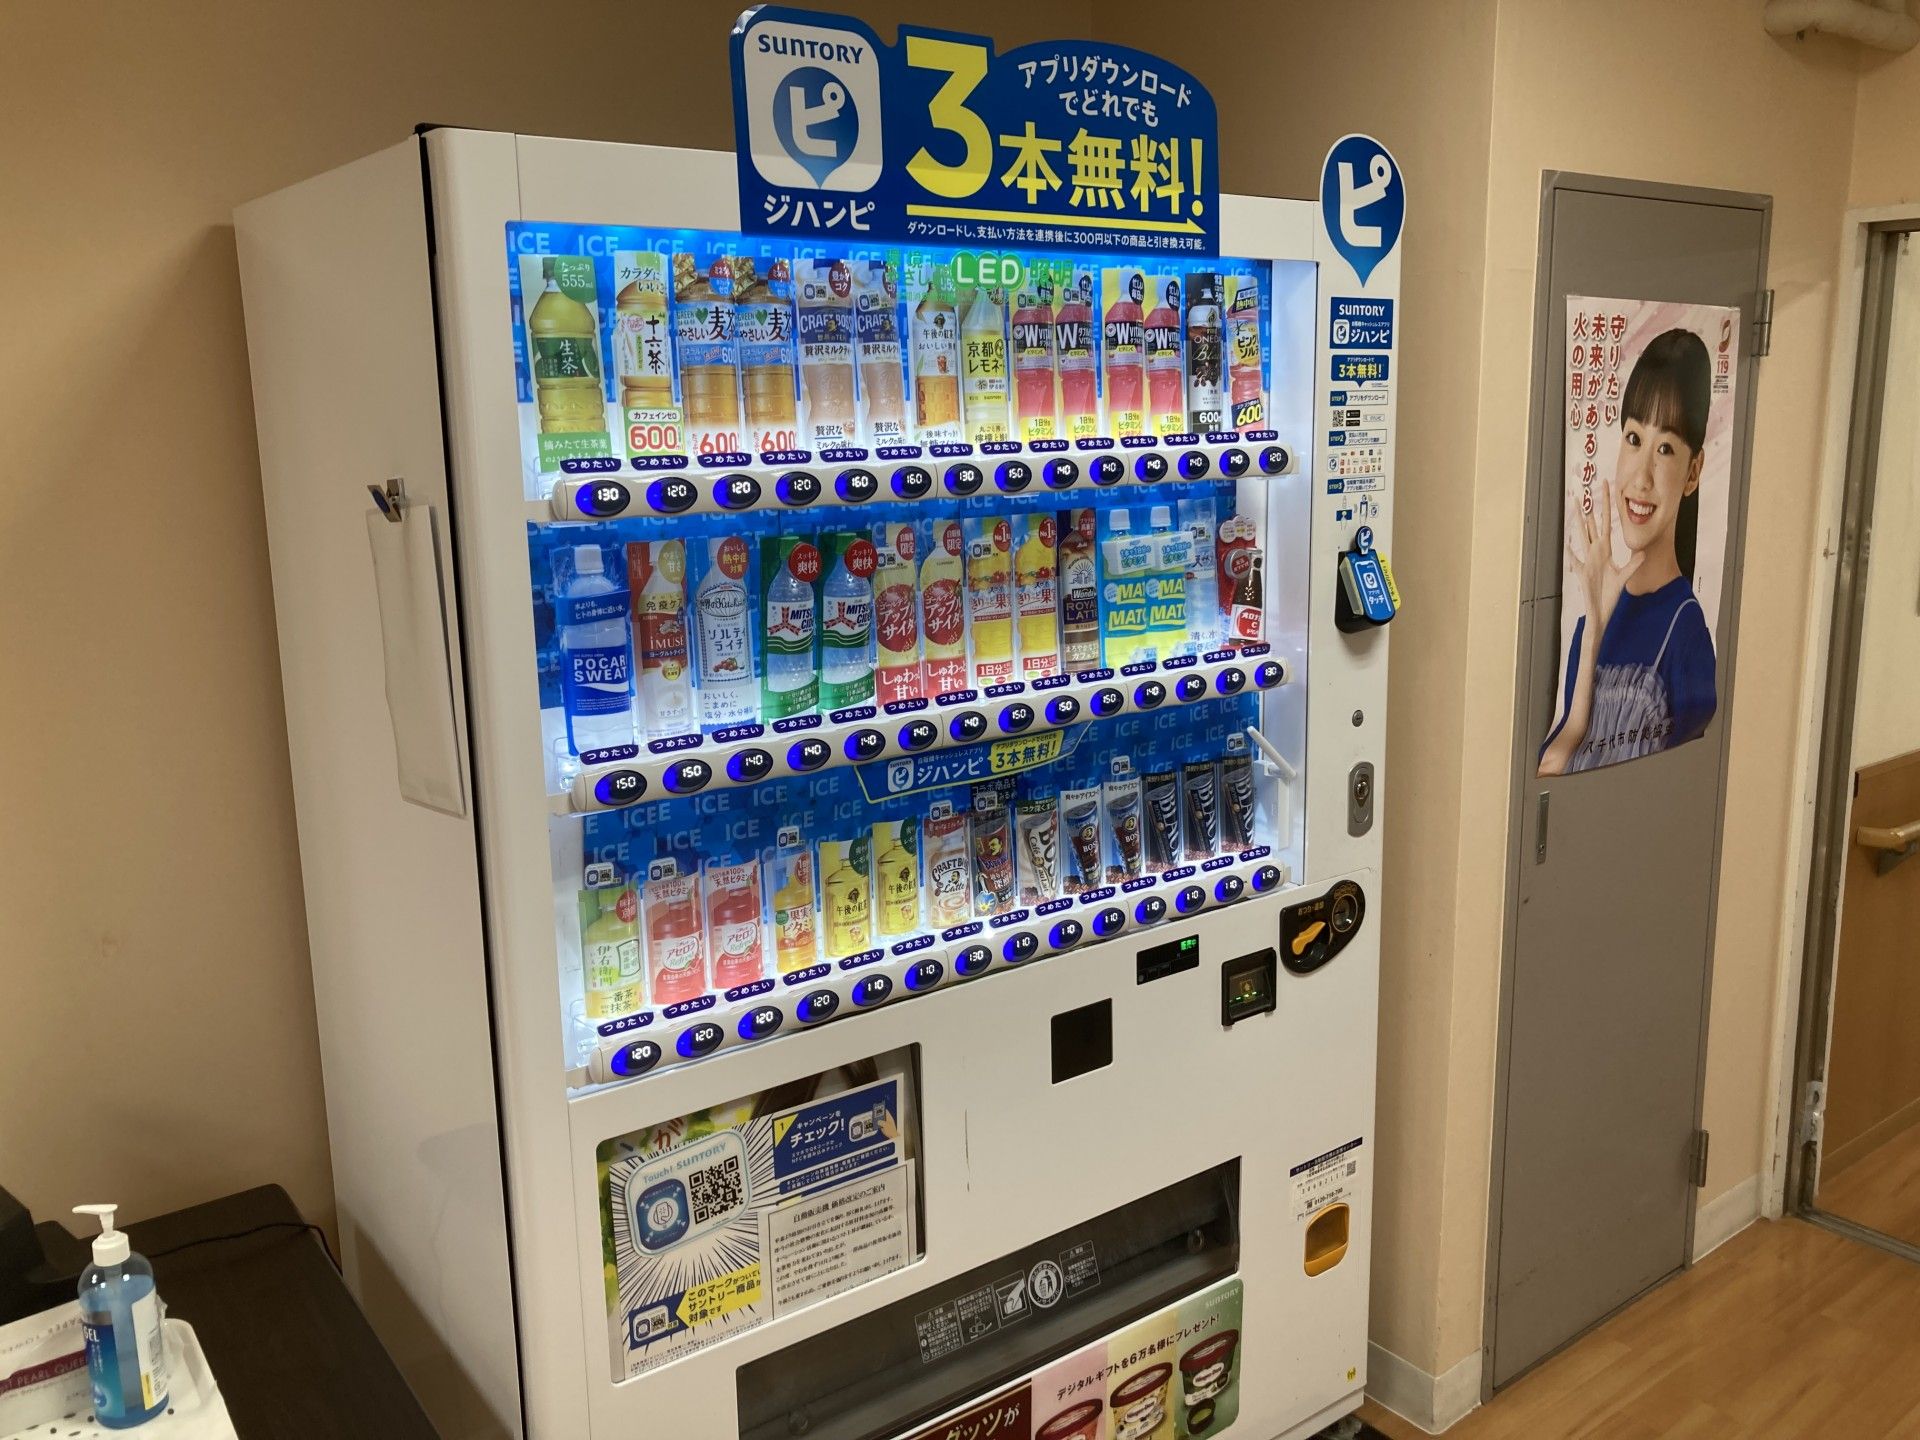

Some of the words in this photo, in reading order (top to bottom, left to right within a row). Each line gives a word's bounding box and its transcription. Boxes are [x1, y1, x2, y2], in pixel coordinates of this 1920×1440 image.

[758, 34, 865, 65] SUNTORY
[1017, 54, 1192, 108] アプリダウンロード
[1059, 90, 1159, 127] でどれでも
[1338, 154, 1392, 248] ピ
[762, 194, 876, 231] ジハンピ
[907, 221, 1207, 251] ダウンロードし、支払い方法を連携後に300円以下の商品と引き換え可能。
[561, 262, 591, 273] たっぷり
[620, 266, 661, 281] カラダに
[956, 257, 1020, 285] LED
[1339, 304, 1385, 316] SUNTORY
[678, 328, 709, 342] やさしい
[739, 329, 770, 342] やさしい
[1024, 324, 1039, 348] W
[1057, 323, 1079, 349] W
[1116, 323, 1130, 346] W
[1154, 328, 1168, 349] W
[1351, 329, 1390, 343] ジハンピ
[644, 314, 665, 374] 十六茶
[558, 340, 579, 375] 生茶
[1339, 363, 1382, 379] 3本無料!
[1570, 312, 1588, 429] 火の用心
[1605, 314, 1626, 424] 守りたい
[1717, 360, 1729, 374] 119
[633, 411, 678, 420] カフェインゼロ
[1236, 404, 1262, 426] 600
[1582, 313, 1607, 514] 未来があるから
[816, 424, 844, 436] 贅沢な
[1207, 432, 1238, 441] つめたい
[1033, 441, 1067, 449] つめたい
[1125, 437, 1155, 445] つめたい
[1168, 434, 1197, 443] つめたい
[825, 449, 865, 459] つめたい
[933, 444, 970, 454] つめたい
[702, 454, 748, 464] つめたい
[1189, 456, 1203, 467] 140
[1269, 452, 1282, 463] 120
[569, 461, 616, 469] つめたい
[1102, 461, 1117, 473] 140
[906, 473, 923, 485] 160
[1008, 467, 1024, 479] 150
[667, 484, 687, 498] 120
[793, 478, 812, 491] 120
[597, 487, 620, 502] 130
[797, 559, 818, 574] 爽快
[852, 557, 873, 570] 爽快
[882, 617, 915, 640] サイダ
[928, 612, 962, 634] サイダ
[714, 639, 743, 652] ライチ
[1166, 657, 1193, 667] つめたい
[1207, 651, 1234, 660] つめたい
[574, 655, 626, 671] POCAR
[1124, 665, 1152, 673] つめたい
[574, 666, 626, 682] SWEAT
[1264, 666, 1277, 677] 130
[938, 677, 963, 691] 甘い
[1036, 676, 1068, 687] つめたい
[1187, 679, 1200, 689] 140
[894, 684, 918, 699] 甘い
[941, 691, 975, 703] つめたい
[1102, 693, 1117, 704] 150
[704, 701, 737, 710] こまめに
[834, 707, 873, 720] つめたい
[1012, 708, 1027, 720] 150
[716, 726, 760, 739] つめたい
[913, 725, 929, 737] 140
[585, 747, 634, 761] つめたい
[804, 744, 822, 756] 140
[995, 742, 1057, 769] 3本無料!
[682, 764, 702, 778] 150
[917, 757, 984, 785] ジハンピ
[616, 776, 637, 790] 150
[1205, 857, 1232, 868] つめたい
[1165, 867, 1194, 879] つめたい
[942, 883, 966, 894] Latte
[1125, 877, 1154, 890] つめたい
[1038, 899, 1071, 912] つめたい
[946, 924, 978, 938] つめたい
[844, 951, 881, 966] つめたい
[969, 949, 984, 962] 130
[729, 980, 771, 998] つめたい
[813, 993, 830, 1007] 120
[610, 1001, 632, 1014] 抹茶
[603, 1014, 649, 1032] つめたい
[692, 1026, 714, 1042] 120
[631, 1045, 652, 1060] 120
[796, 1110, 841, 1129] キャンペーンを
[790, 1118, 845, 1149] チェック!
[644, 1166, 673, 1184] Touch!
[676, 1142, 727, 1170] SUNTORY
[688, 1305, 722, 1323] 対象です
[1057, 1313, 1221, 1400] デジタルギフトを6万名様にプレゼント!
